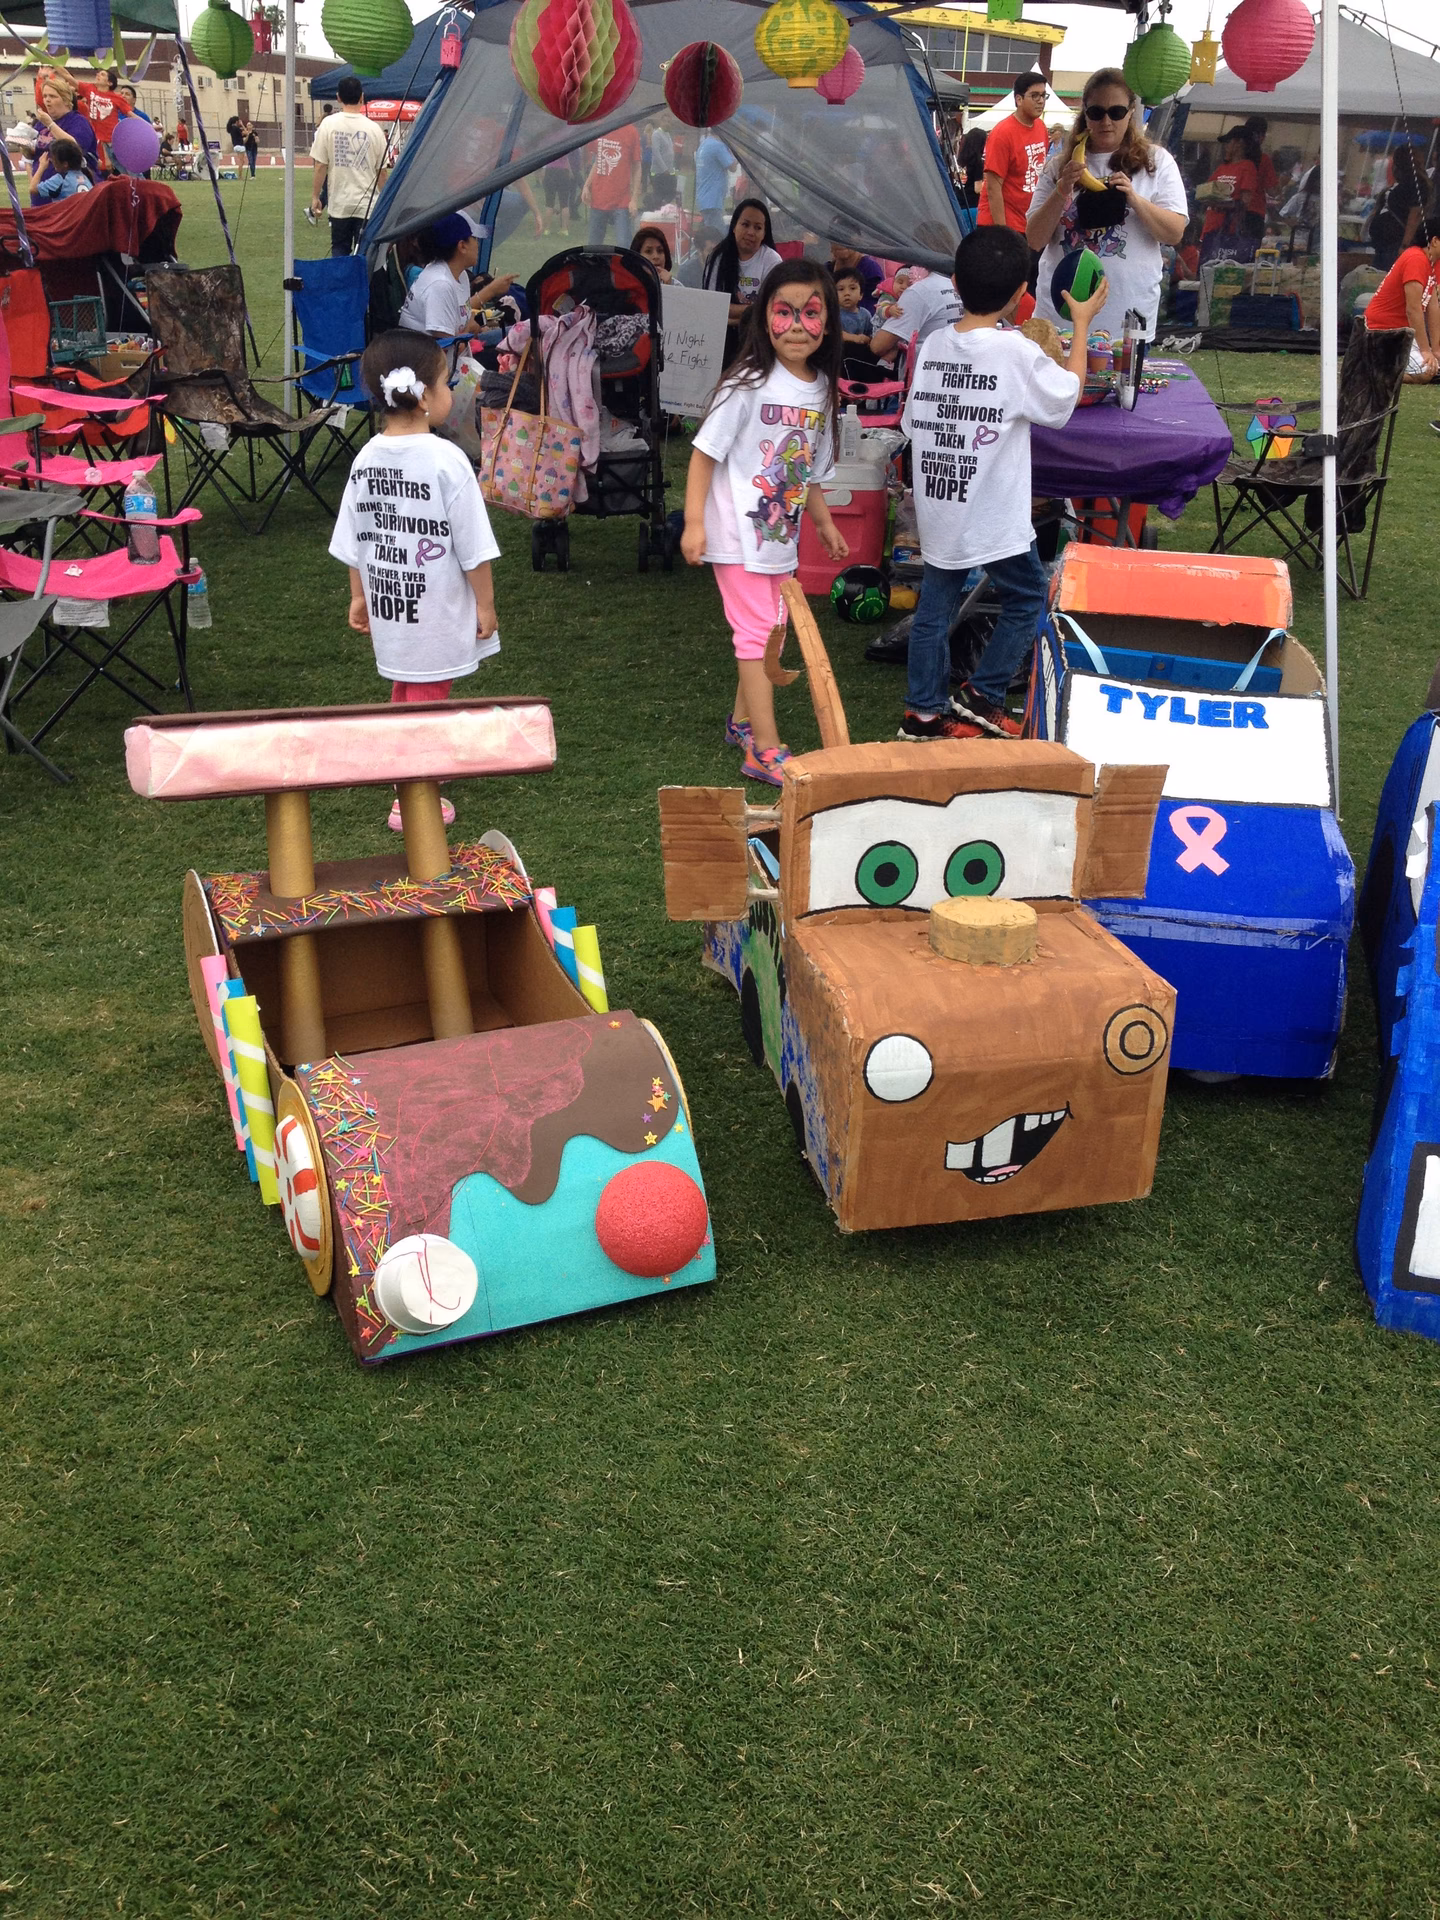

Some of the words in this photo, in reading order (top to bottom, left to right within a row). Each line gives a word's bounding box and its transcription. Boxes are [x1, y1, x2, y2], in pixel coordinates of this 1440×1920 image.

[676, 330, 705, 348] Night
[680, 350, 708, 370] Fight
[960, 363, 973, 373] THE
[941, 372, 998, 391] FIGHTERS
[948, 394, 960, 404] THE
[760, 404, 826, 432] UNITE
[936, 403, 1004, 423] SURVIVORS
[945, 423, 957, 433] THE
[934, 432, 966, 450] TAKEN
[921, 450, 936, 460] AND
[958, 455, 978, 465] EVER
[388, 468, 403, 480] THE
[921, 460, 956, 479] GIVING
[960, 465, 977, 480] UP
[367, 478, 431, 501] FIGHTERS
[925, 475, 969, 503] HOPE
[383, 502, 397, 514] THE
[374, 512, 450, 537] SURVIVORS
[384, 534, 397, 546] THE
[374, 543, 408, 565] TAKEN
[402, 571, 426, 582] EVER
[404, 582, 426, 599] UP
[371, 591, 419, 624] HOPE
[1099, 683, 1270, 729] TYLER
